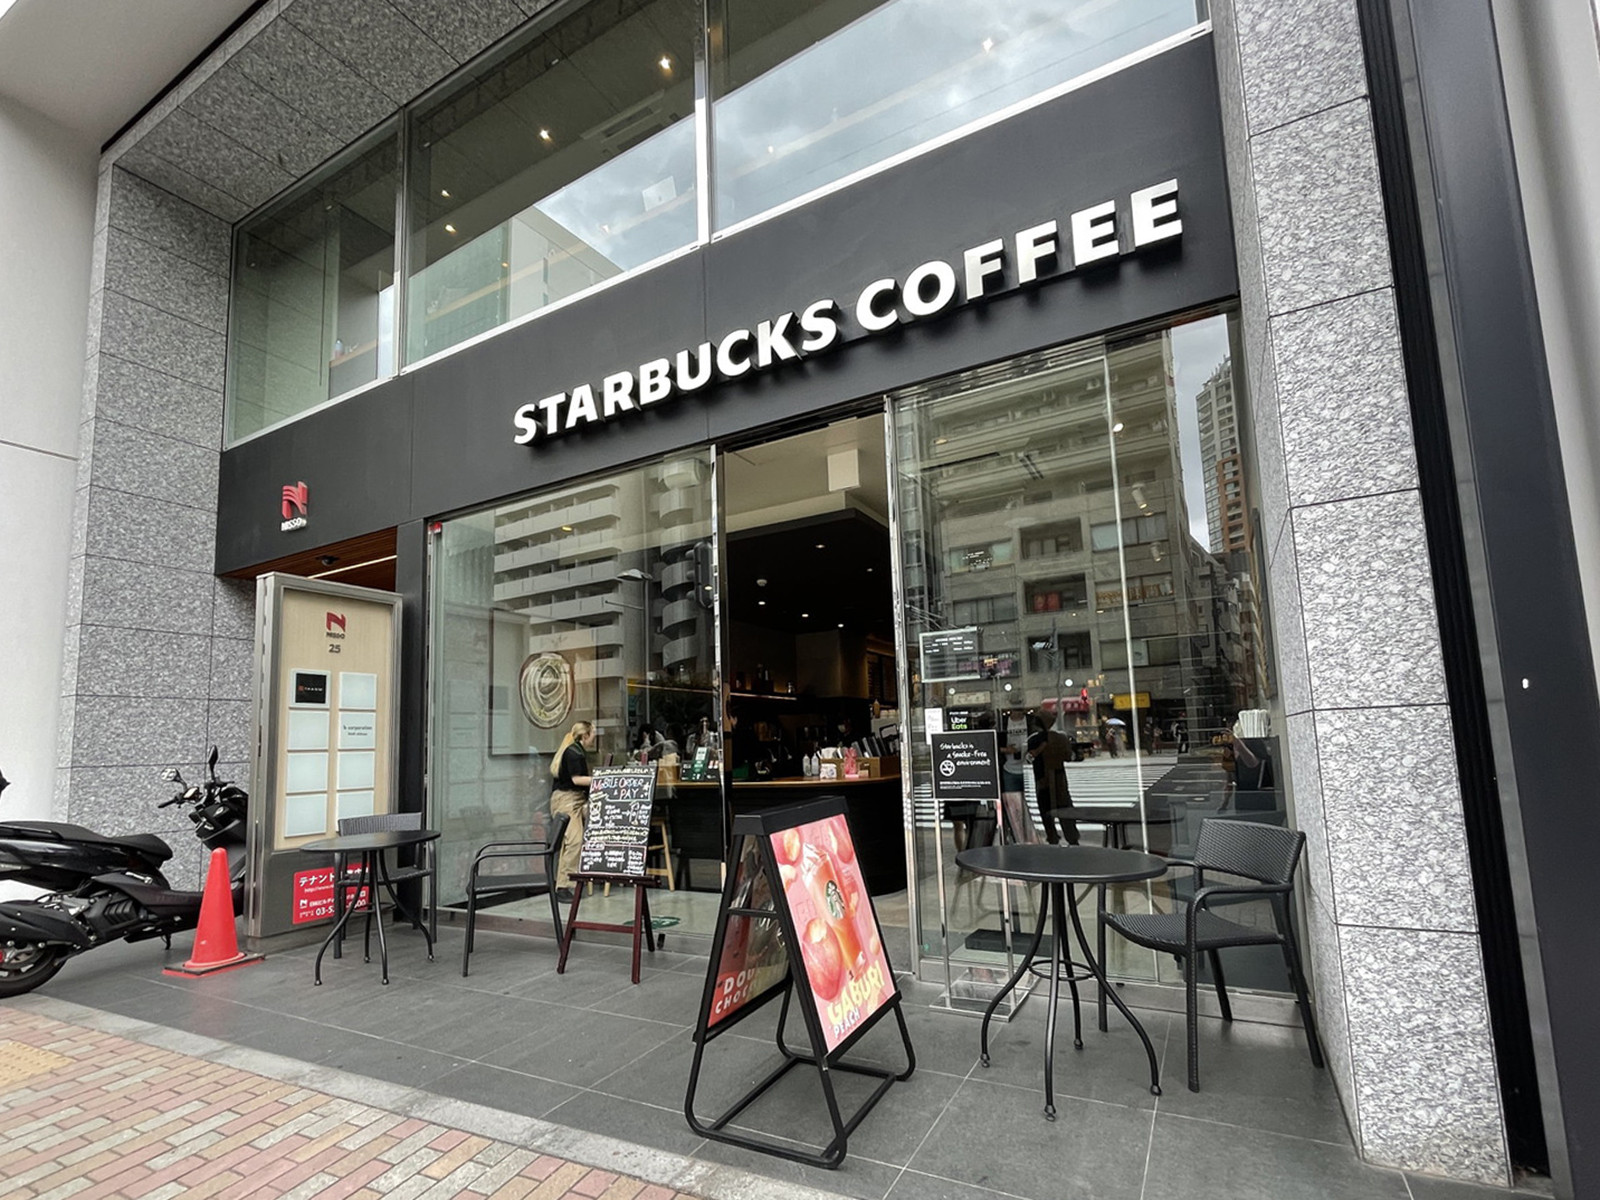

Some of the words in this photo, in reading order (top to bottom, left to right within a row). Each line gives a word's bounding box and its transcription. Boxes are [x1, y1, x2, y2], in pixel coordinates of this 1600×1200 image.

[513, 299, 839, 446] STARBUCKS
[855, 178, 1183, 332] COFFEE
[328, 643, 342, 654] 25
[620, 788, 640, 801] PAY
[827, 960, 885, 1026] GABURI
[833, 1007, 861, 1039] PEACH
